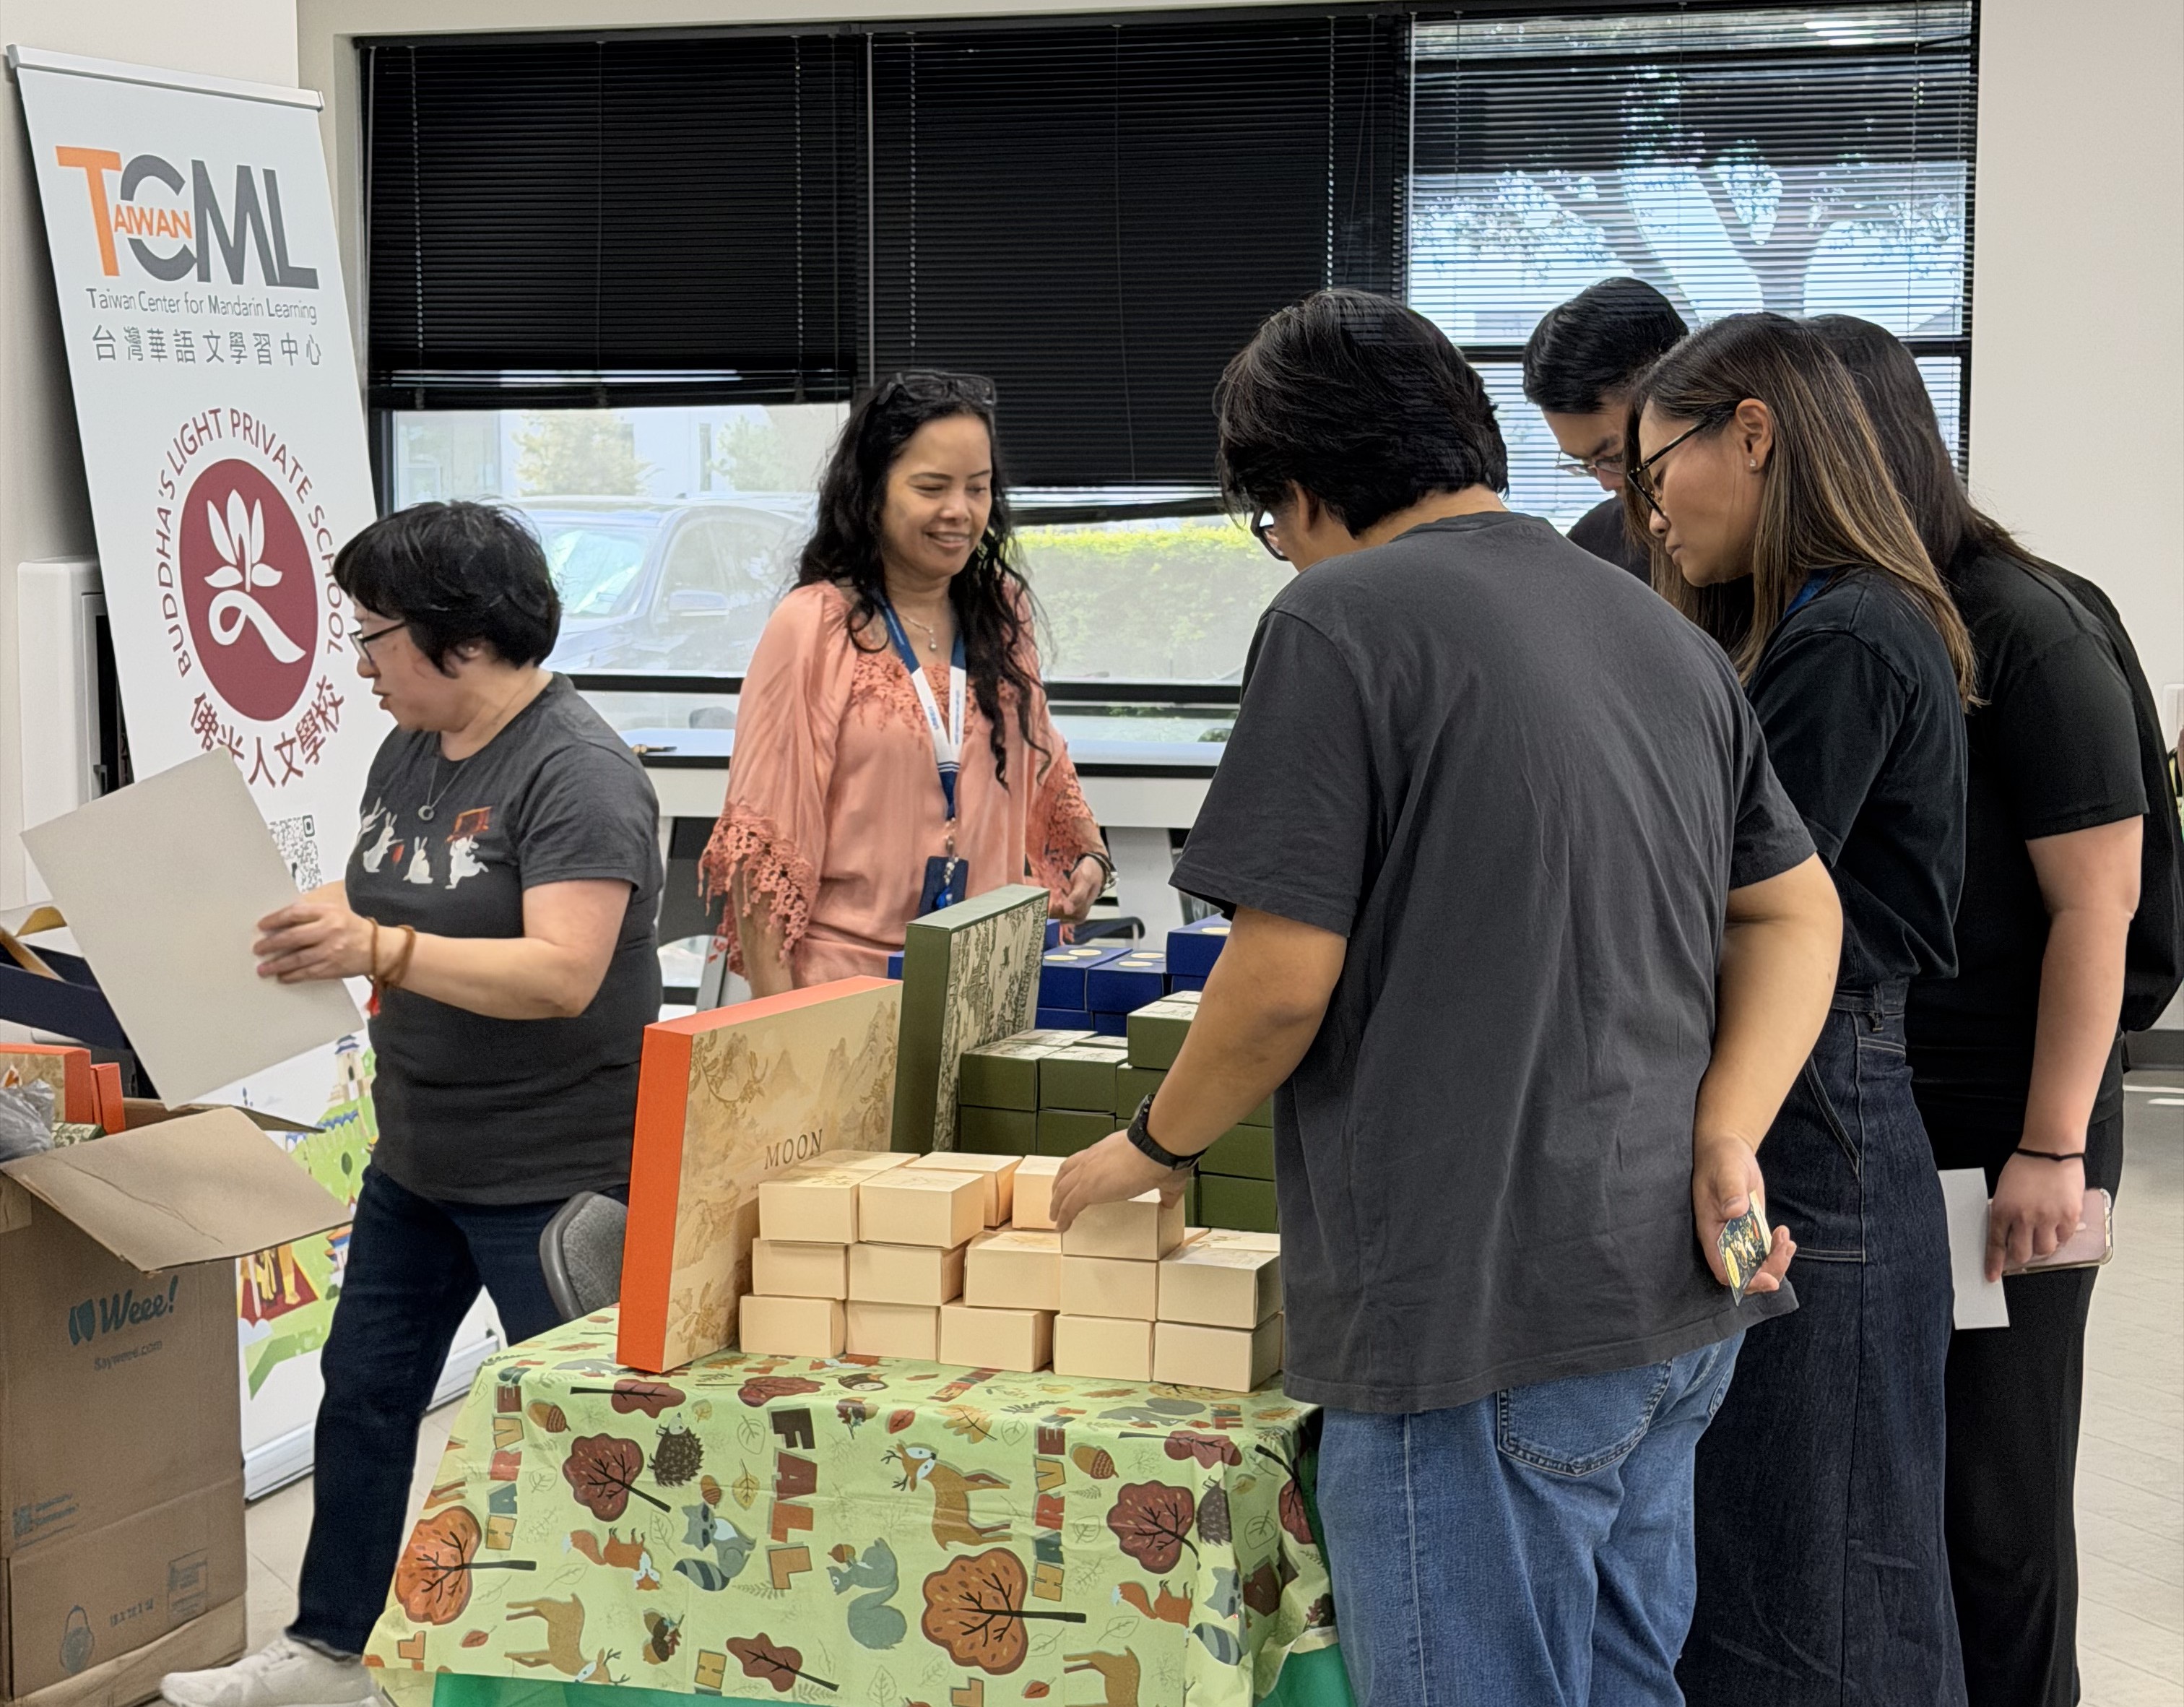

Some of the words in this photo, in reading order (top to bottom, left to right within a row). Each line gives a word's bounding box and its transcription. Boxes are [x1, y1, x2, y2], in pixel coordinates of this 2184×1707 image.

[55, 145, 319, 290] TCML
[85, 288, 137, 310] Taiwan
[138, 290, 181, 314] Center
[184, 291, 204, 314] for
[207, 294, 264, 317] Mandarin
[266, 298, 318, 326] Learning
[92, 324, 322, 366] 台灣華語文學習中心
[166, 407, 222, 477] LIGHT
[229, 407, 313, 504] PRIVATE
[155, 469, 192, 678] BUDDHA'S
[764, 1128, 823, 1170] MOON
[99, 1274, 179, 1334] Weee!
[768, 1406, 818, 1591] FALL
